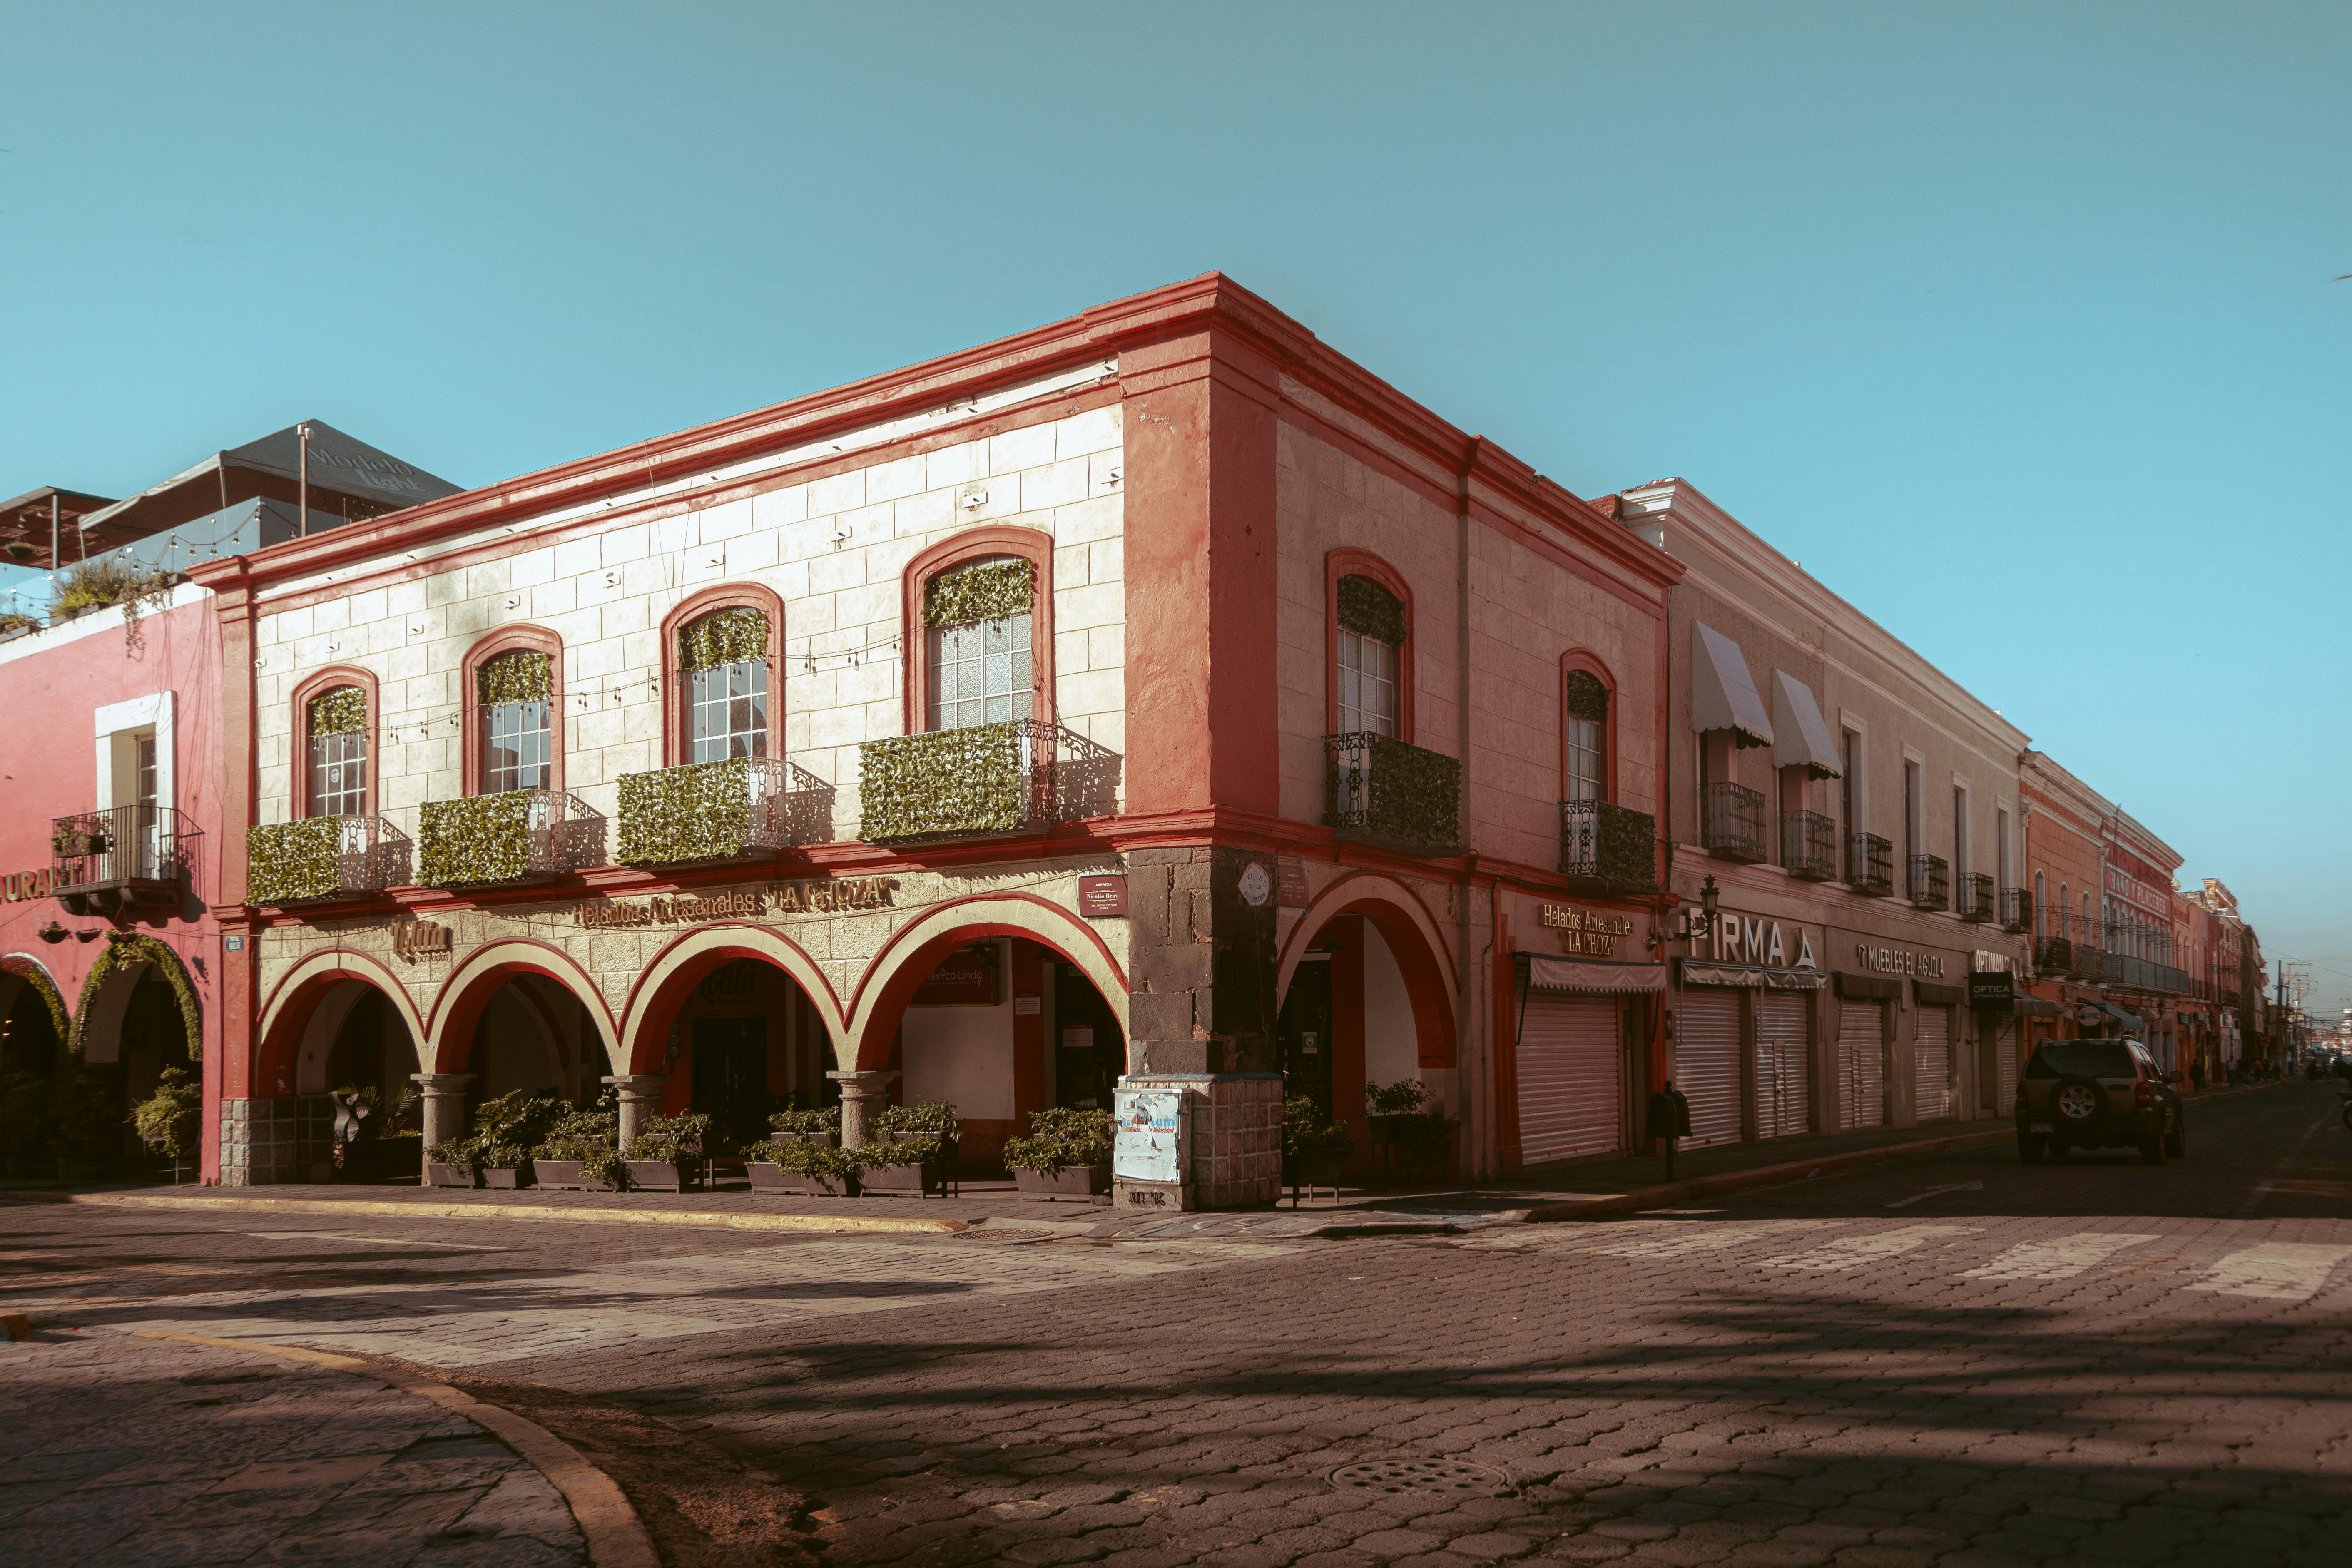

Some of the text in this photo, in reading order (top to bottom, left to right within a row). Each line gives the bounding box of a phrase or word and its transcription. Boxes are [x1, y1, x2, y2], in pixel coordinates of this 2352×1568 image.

[307, 447, 414, 475] Modelo
[356, 469, 426, 492] Light
[573, 900, 640, 925] Helados
[648, 891, 755, 919] Artesanales
[2111, 871, 2166, 914] BAÑO Y PLACERES
[1543, 904, 1633, 936] Helados Artesanales
[1690, 907, 1787, 966] PIRMA
[1869, 946, 1944, 978] MUEBLES EL AGUILA
[1976, 949, 2004, 972] OPTIMAN
[958, 969, 983, 986] Lindo
